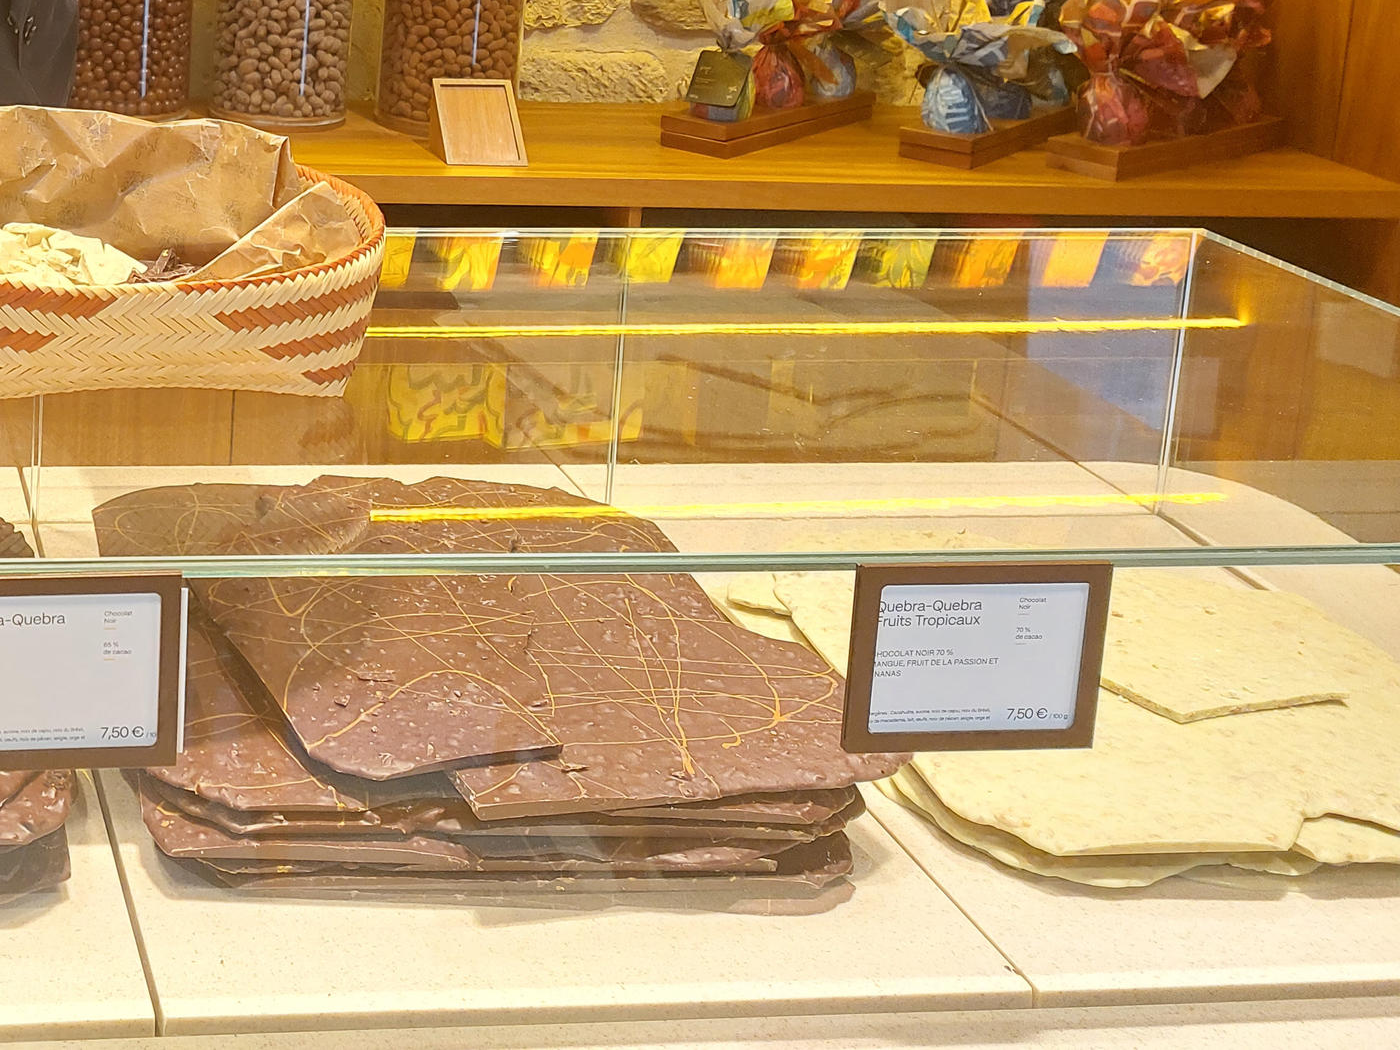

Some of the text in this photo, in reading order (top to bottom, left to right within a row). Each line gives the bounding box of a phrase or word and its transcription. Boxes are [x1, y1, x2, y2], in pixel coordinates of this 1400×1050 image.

[879, 599, 982, 614] Quebra-Quebra
[915, 614, 981, 628] Tropicaux
[877, 649, 914, 657] HOCOLAT
[915, 649, 935, 657] NOIR
[946, 648, 954, 656] %
[874, 657, 999, 667] ANGUE, FRUIT DE LA PASSION ET
[1007, 707, 1034, 721] 7,50
[1036, 707, 1048, 719] €
[100, 726, 129, 740] 7,50
[132, 725, 144, 738] €
